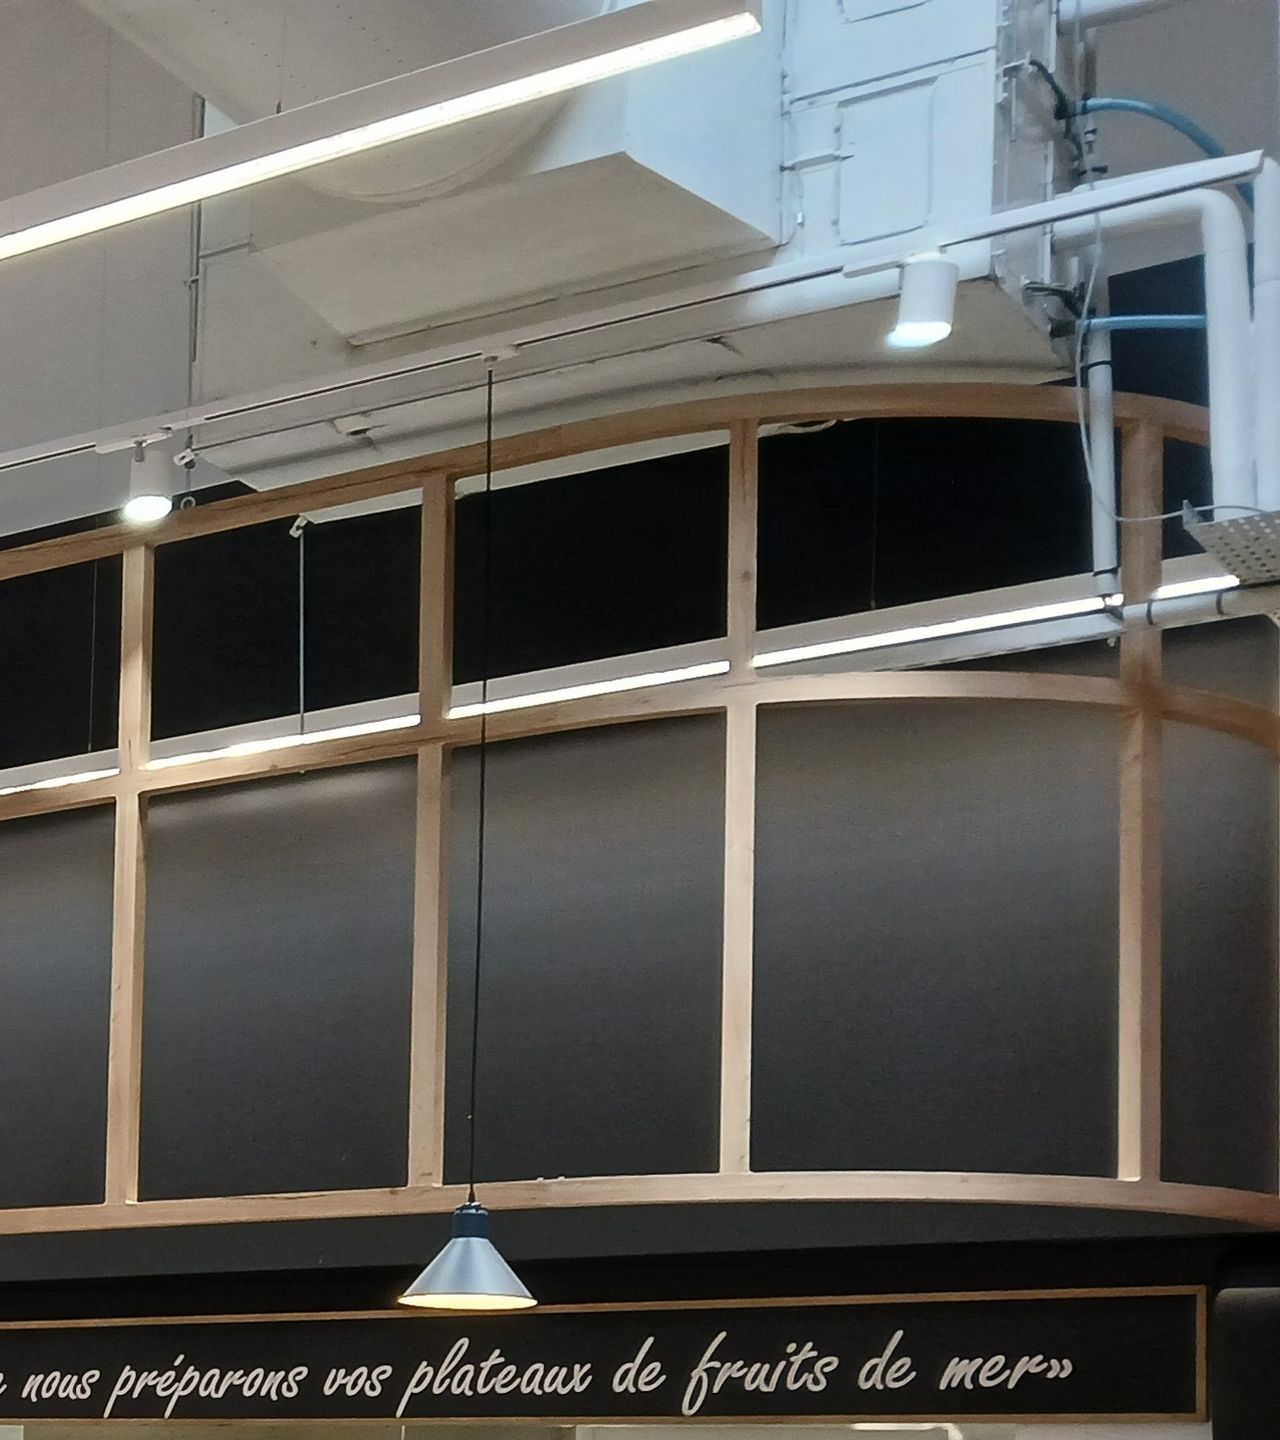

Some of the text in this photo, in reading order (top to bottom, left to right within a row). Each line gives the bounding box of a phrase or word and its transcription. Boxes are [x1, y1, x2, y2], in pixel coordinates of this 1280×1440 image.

[22, 1368, 100, 1403] nous
[103, 1354, 308, 1419] préparons
[323, 1366, 392, 1397] vos
[395, 1337, 592, 1418] plateaux
[612, 1336, 667, 1394] de
[682, 1331, 839, 1417] fruits
[858, 1330, 916, 1390] de
